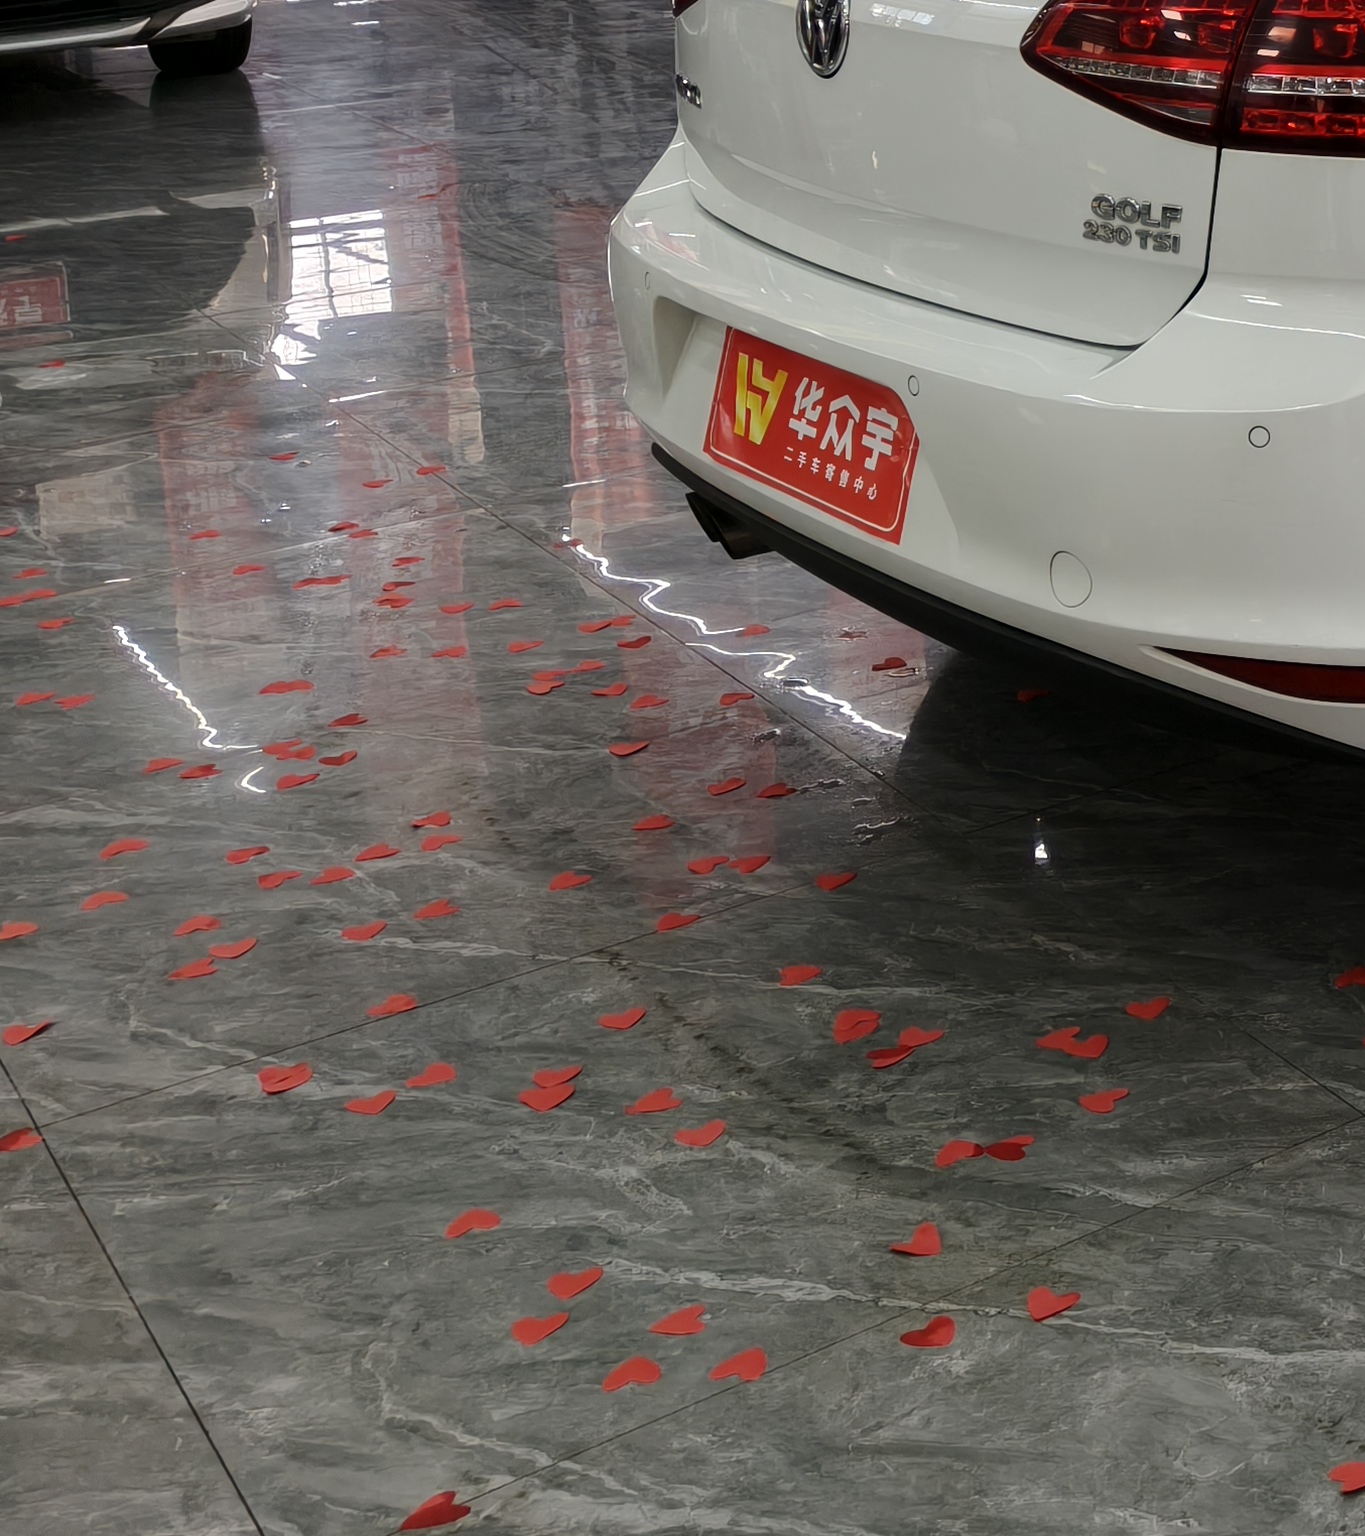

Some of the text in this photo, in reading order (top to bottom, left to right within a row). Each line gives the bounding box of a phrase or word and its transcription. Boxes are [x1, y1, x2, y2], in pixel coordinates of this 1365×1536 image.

[1090, 192, 1183, 230] GOLF
[1082, 218, 1181, 255] 230 TSI
[788, 376, 899, 472] 华众宇
[783, 446, 878, 501] 二手车寄售中心
